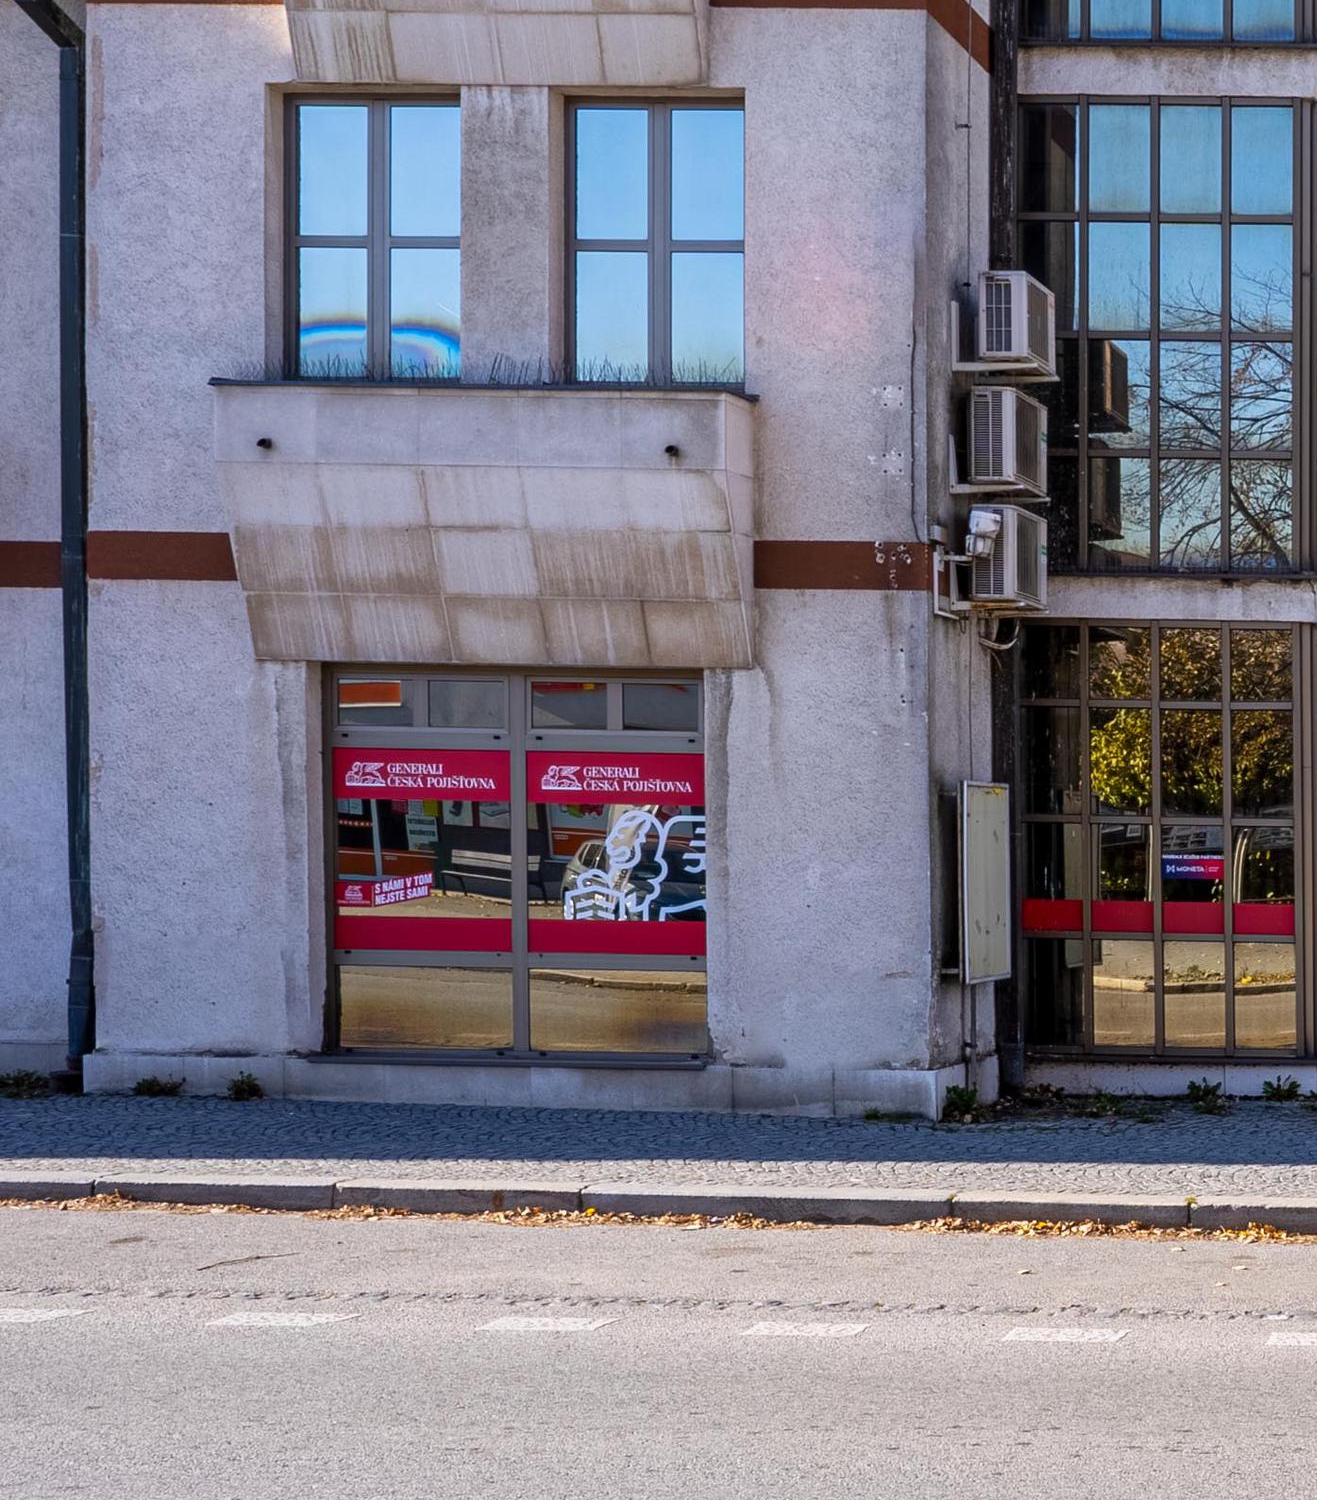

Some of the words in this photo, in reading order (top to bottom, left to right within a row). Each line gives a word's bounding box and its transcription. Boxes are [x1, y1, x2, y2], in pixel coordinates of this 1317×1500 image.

[386, 763, 443, 775] GENERALI
[582, 766, 640, 779] GENERALI
[386, 774, 424, 788] ČESKÁ
[427, 775, 496, 790] POJIŠŤOVNA
[582, 778, 621, 792] ČESKÁ
[623, 779, 693, 793] POJIŠŤOVNA
[374, 882, 381, 894] S
[382, 877, 405, 892] NÁMI
[405, 877, 413, 888] V
[414, 873, 433, 886] TOM
[374, 889, 405, 906] NEJSTE
[406, 886, 429, 899] SAMI
